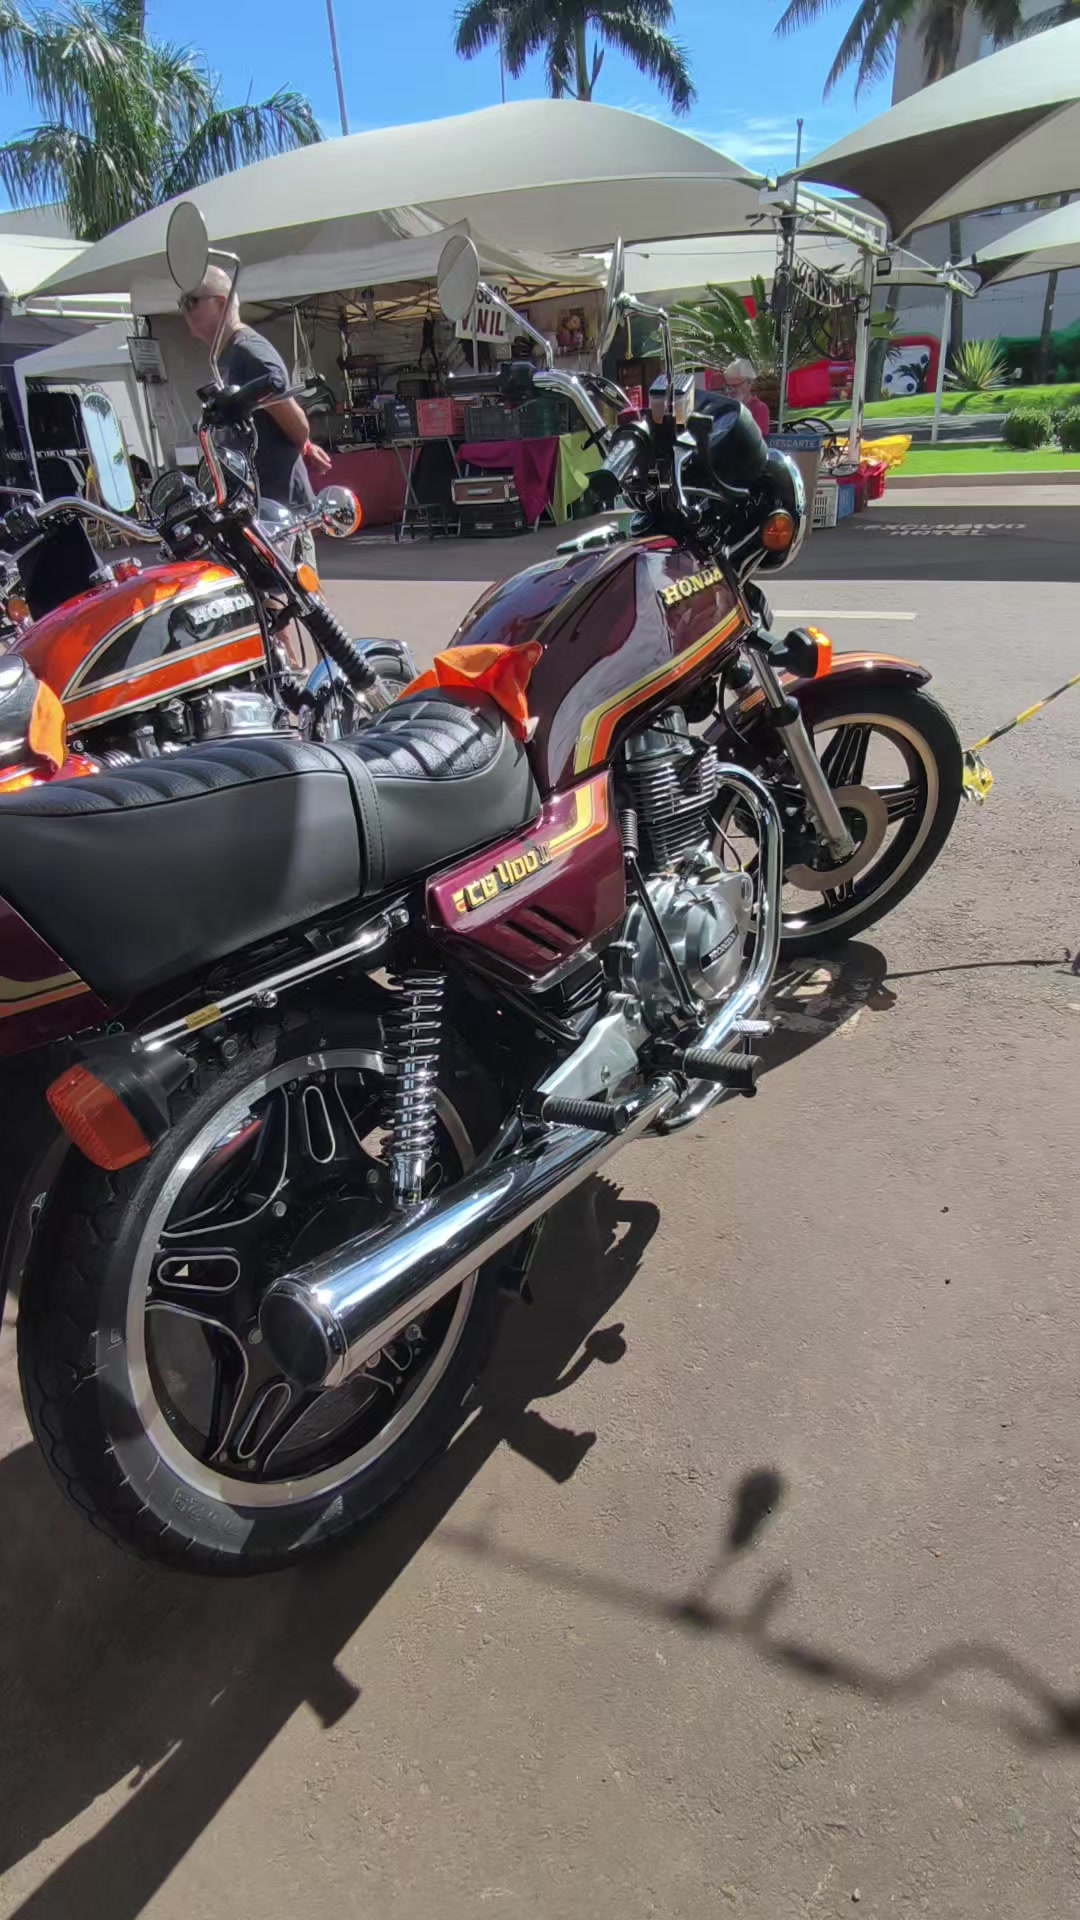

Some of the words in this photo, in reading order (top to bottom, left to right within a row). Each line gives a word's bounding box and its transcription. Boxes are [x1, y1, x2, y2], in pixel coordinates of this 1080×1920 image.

[461, 308, 504, 336] VNIL
[861, 522, 1027, 530] EXCLUSIVO
[664, 566, 724, 606] HONDA
[185, 592, 255, 625] HONDA
